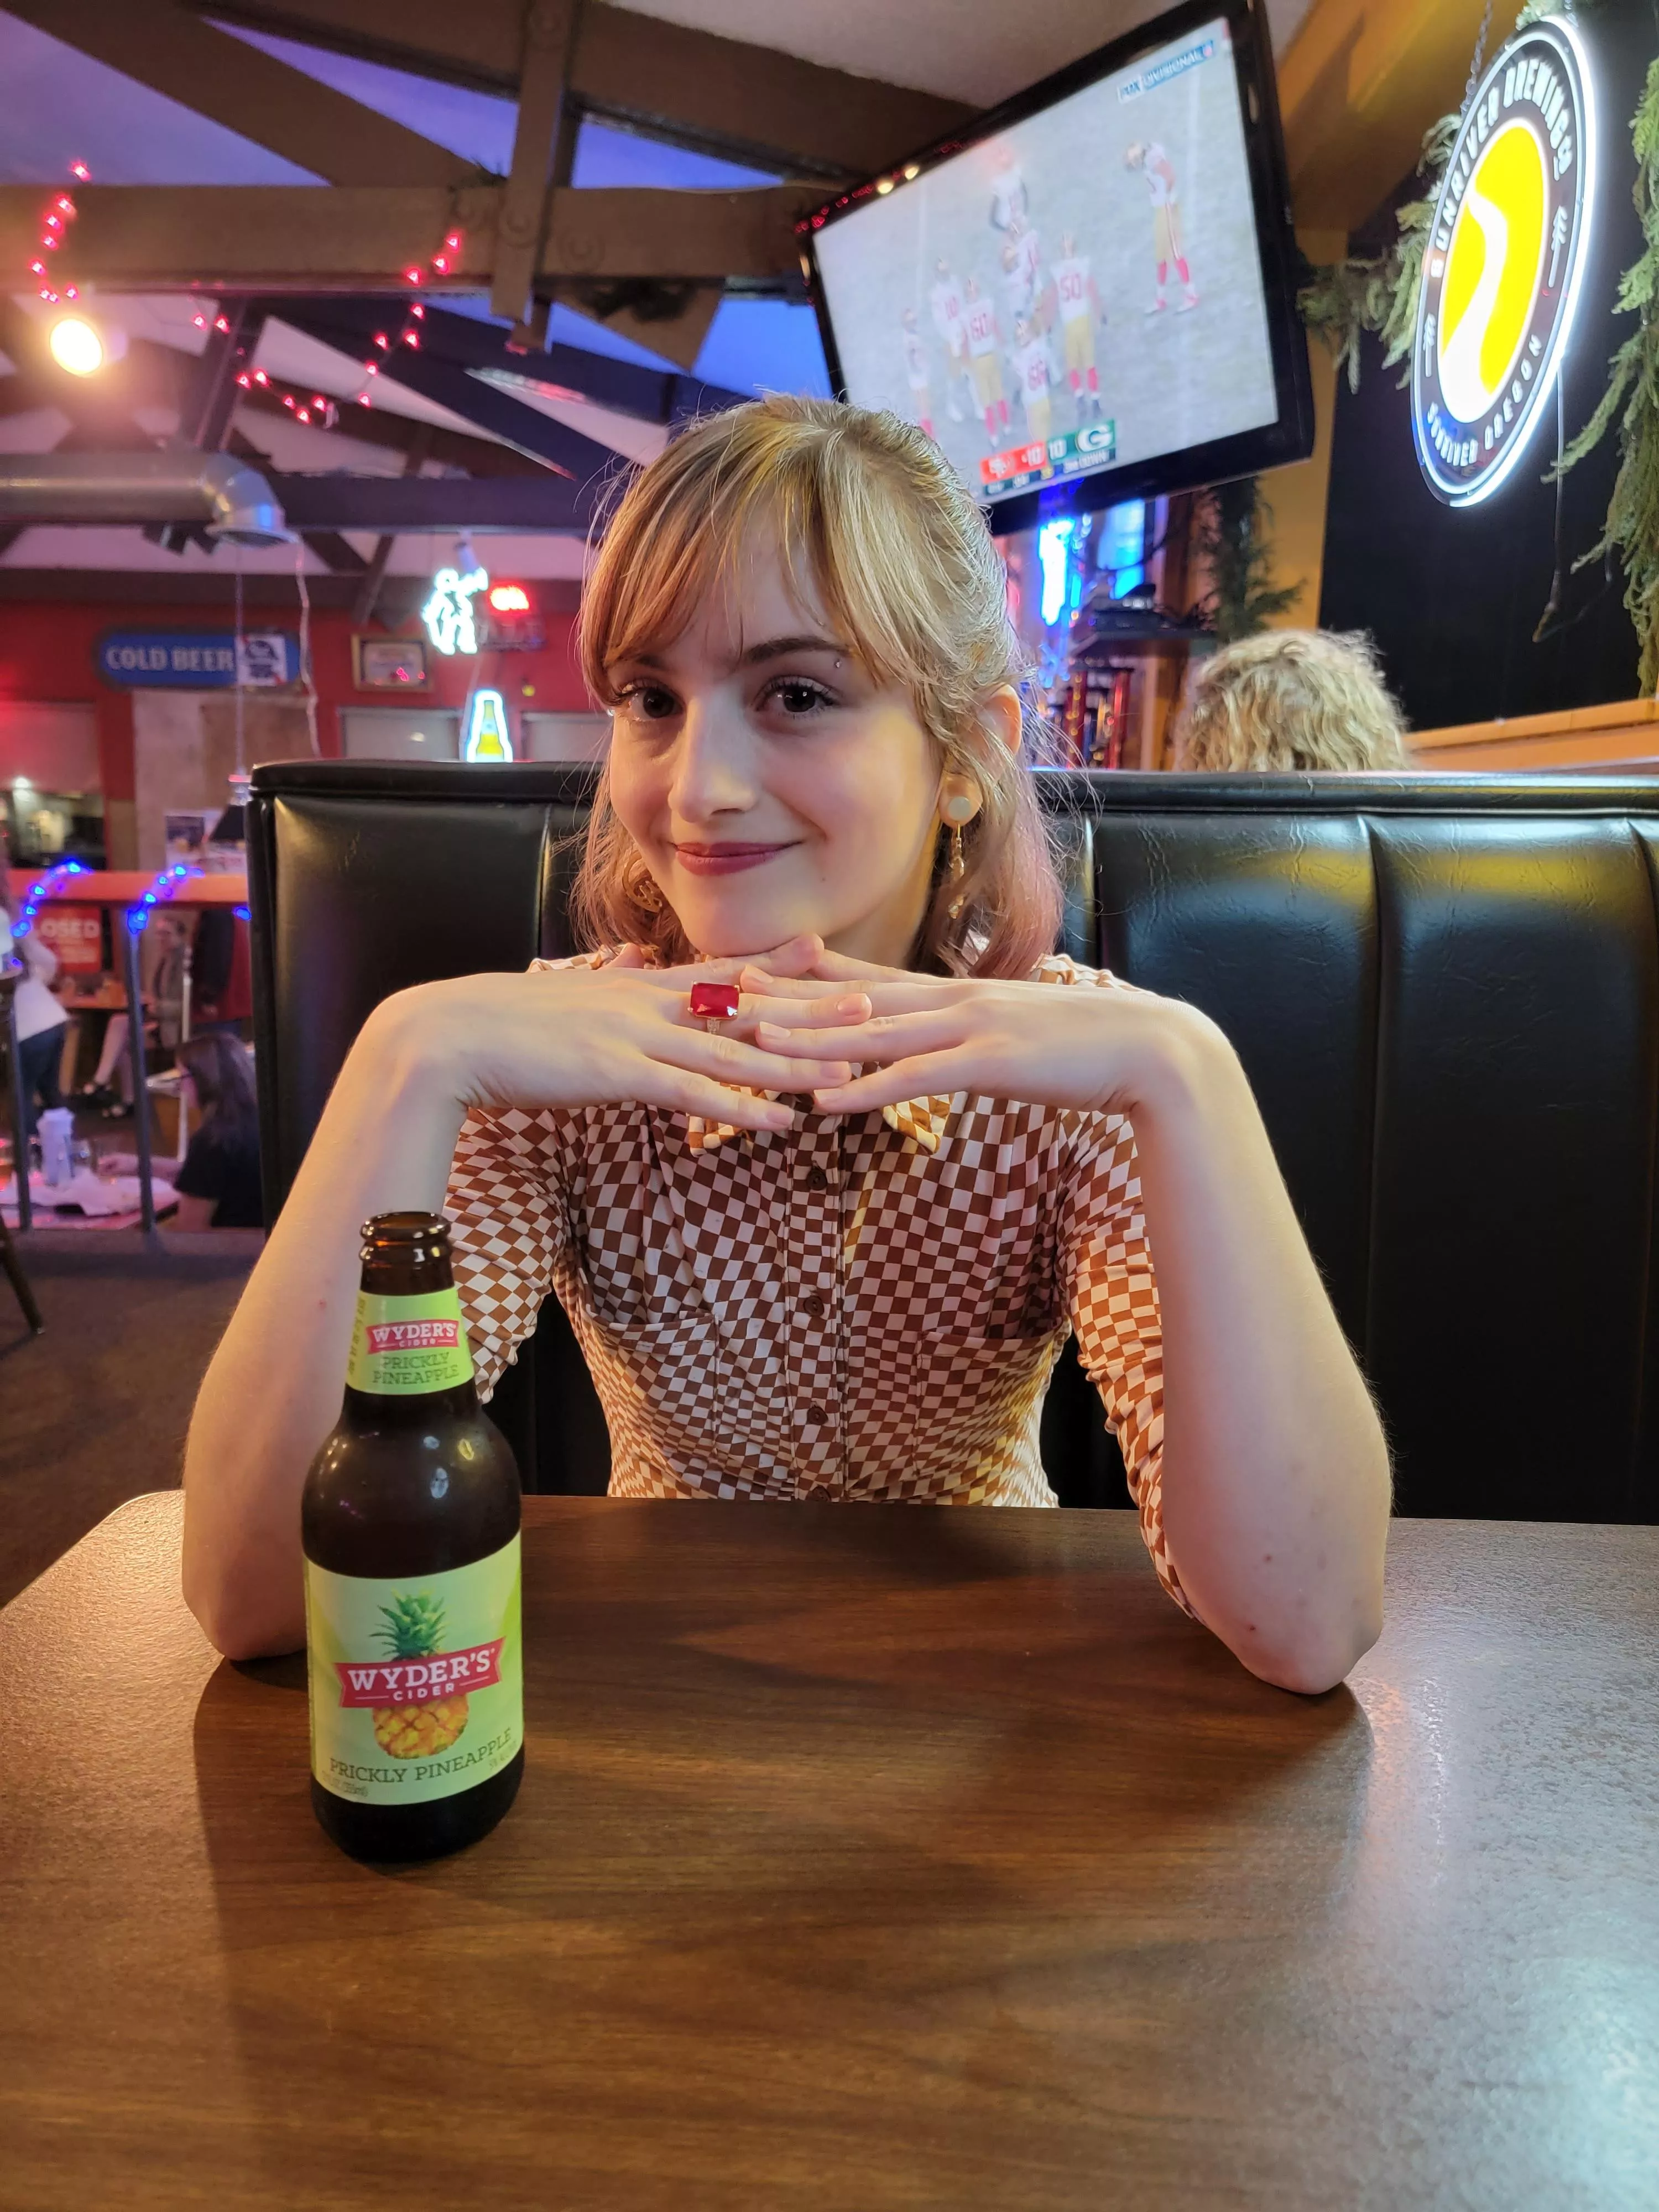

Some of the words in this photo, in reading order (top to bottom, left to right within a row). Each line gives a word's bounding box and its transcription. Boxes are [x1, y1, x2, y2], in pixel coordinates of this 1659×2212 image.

[106, 647, 166, 671] COLD
[170, 647, 234, 671] BEER
[373, 1323, 456, 1342] WYDER'S
[399, 1338, 436, 1348] CIDER
[383, 1352, 450, 1369] PRICKLY
[372, 1364, 460, 1385] PINEAPPLE
[347, 1649, 492, 1691] WYDER'S
[393, 1682, 456, 1702] CIDER
[330, 1757, 408, 1783] PRICKLY
[414, 1726, 512, 1781] PINEAPPLE
